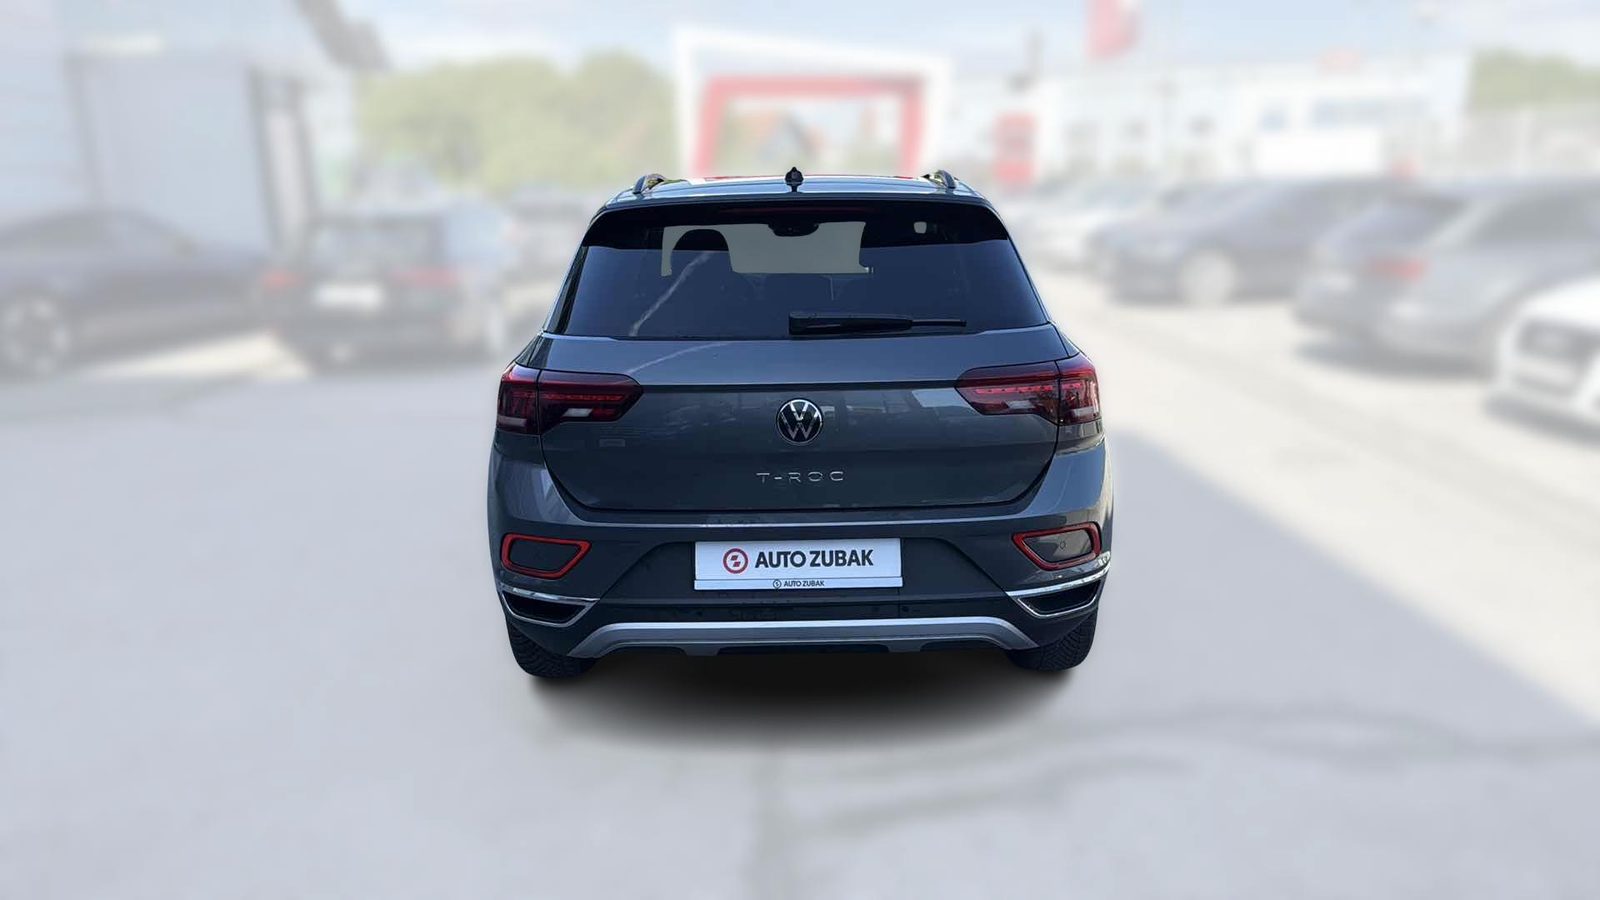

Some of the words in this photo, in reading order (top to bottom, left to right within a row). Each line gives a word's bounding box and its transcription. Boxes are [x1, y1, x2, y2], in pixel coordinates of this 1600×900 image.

[756, 471, 844, 483] T-ROC
[755, 551, 806, 568] AUTO
[809, 549, 874, 567] ZUBAK
